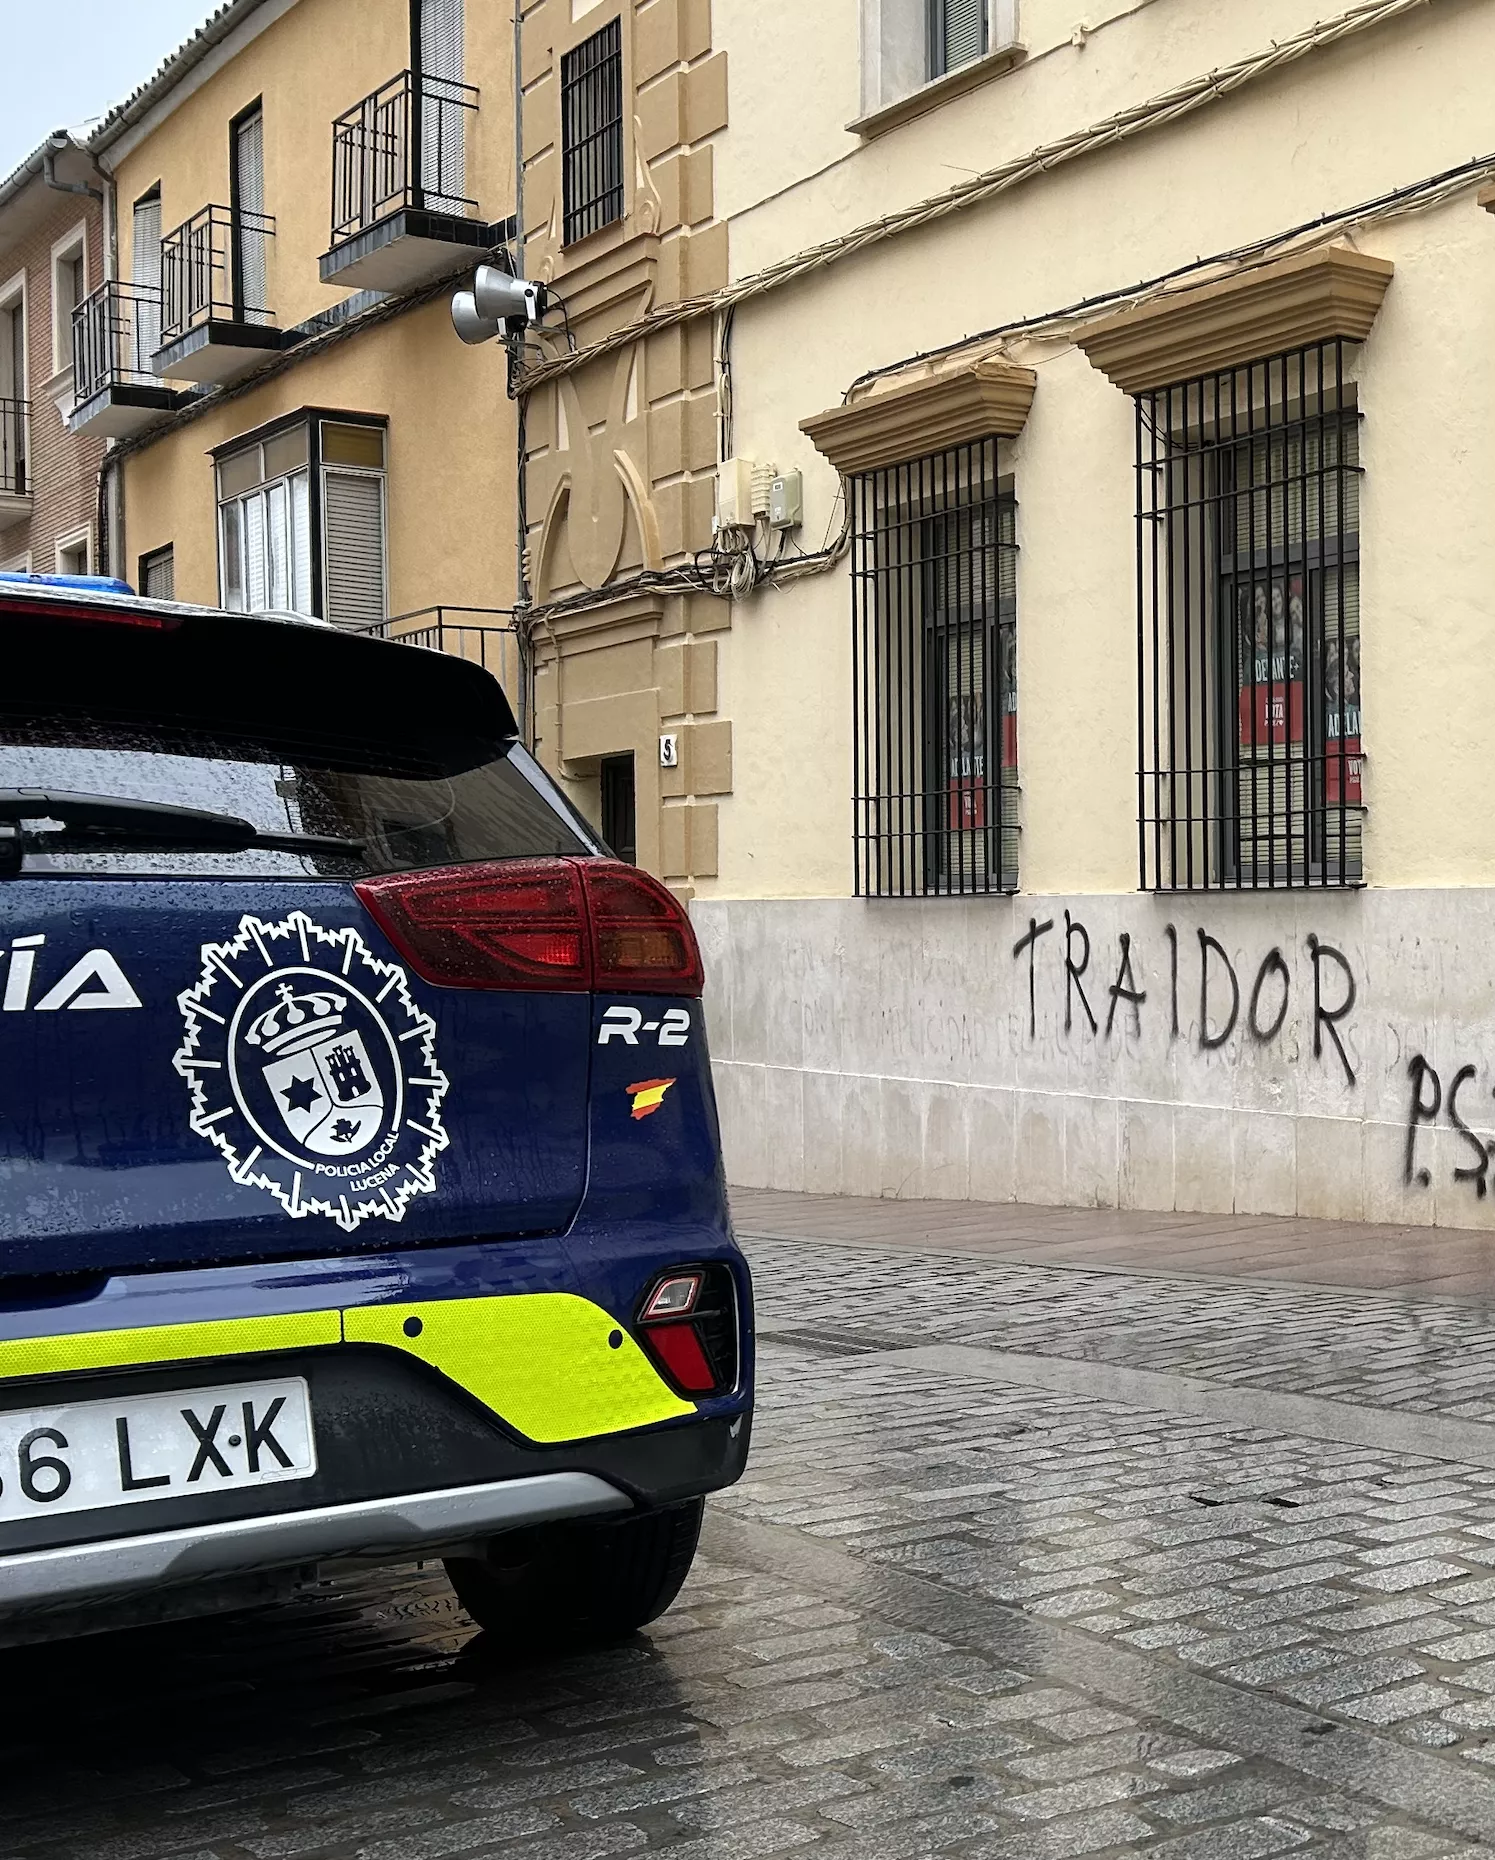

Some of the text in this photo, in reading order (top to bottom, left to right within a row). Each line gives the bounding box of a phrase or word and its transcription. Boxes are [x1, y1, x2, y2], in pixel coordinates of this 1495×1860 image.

[0, 933, 143, 1011] ÍA
[1013, 909, 1357, 1087] TRAIDOR
[598, 1006, 691, 1046] R-2
[315, 1132, 400, 1177] POLICIA LOCAL
[349, 1162, 400, 1192] LUCENA
[0, 1396, 295, 1503] 6 LXK
